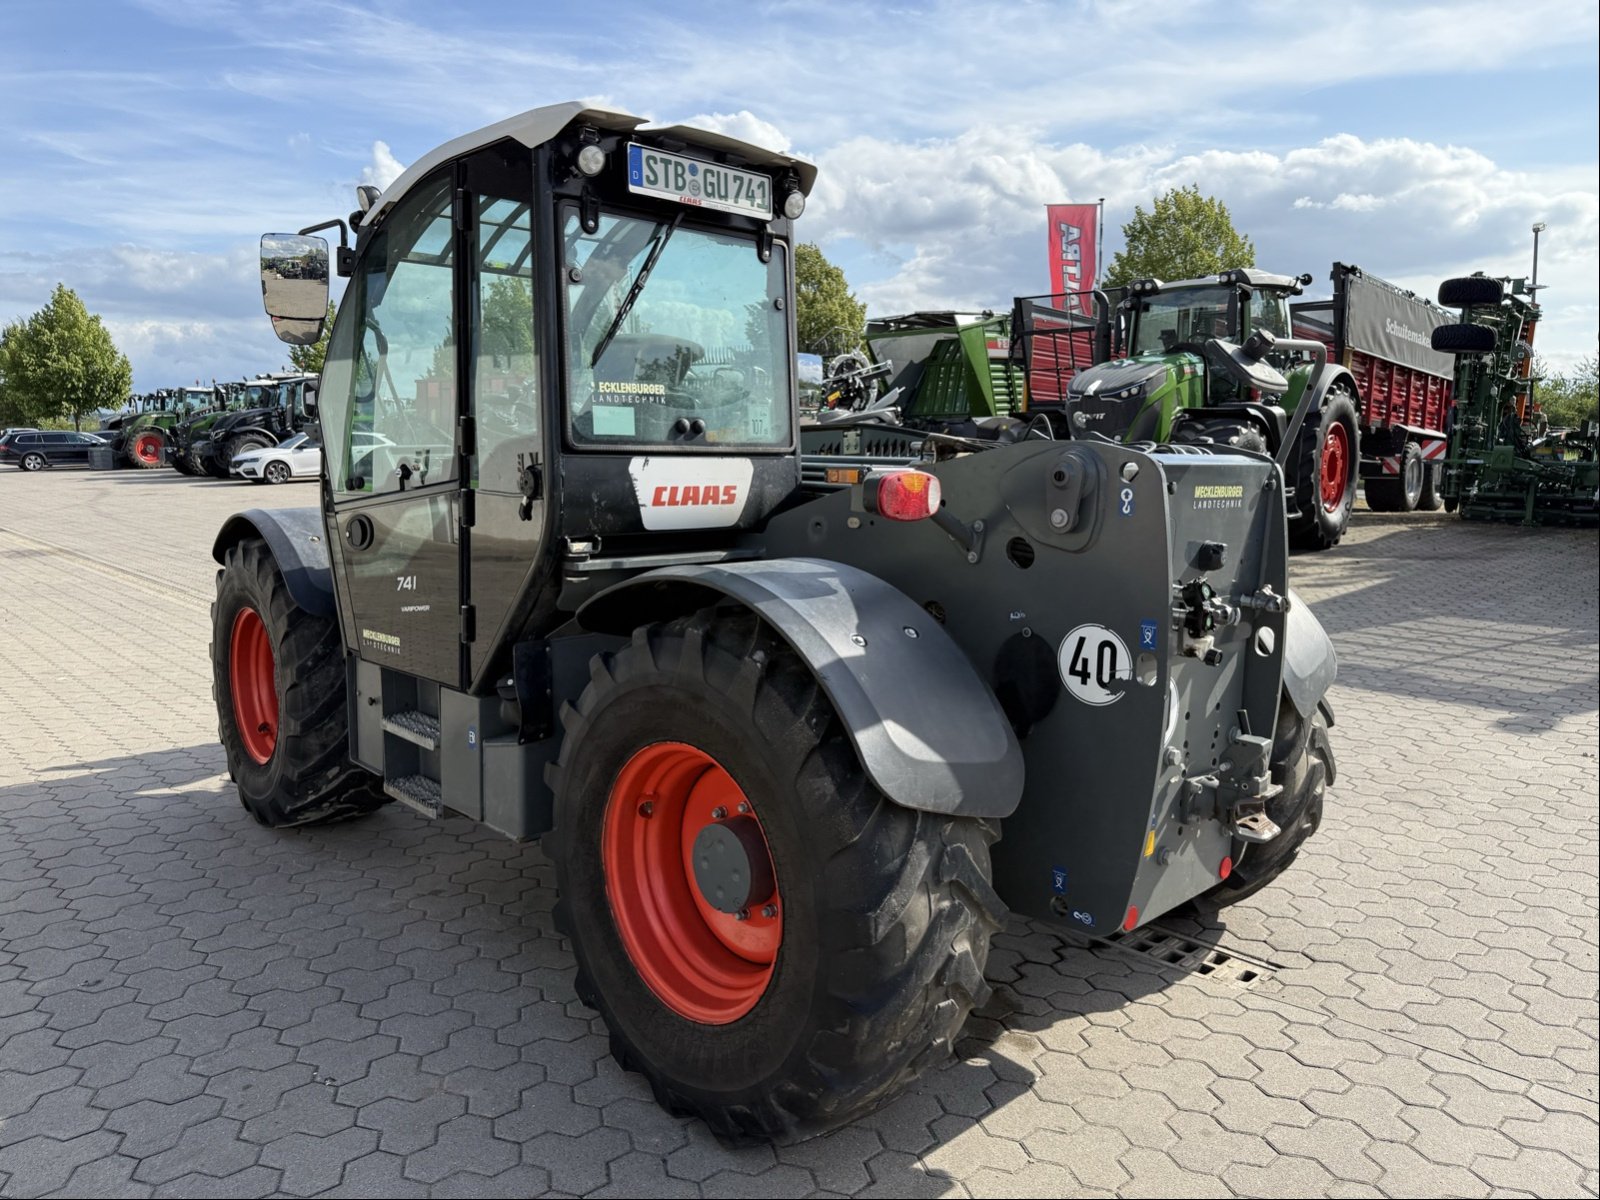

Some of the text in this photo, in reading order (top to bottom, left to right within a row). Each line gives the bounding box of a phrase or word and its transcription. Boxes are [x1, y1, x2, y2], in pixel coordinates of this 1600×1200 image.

[632, 170, 639, 180] D
[645, 154, 769, 210] STB GU 741
[652, 485, 737, 507] CLAAS
[1194, 485, 1243, 498] MECKLENBURGER
[1193, 499, 1242, 510] LANDTECHNIK
[396, 575, 417, 592] 741
[362, 628, 401, 647] MECKLENBURGER
[1068, 636, 1118, 690] 40
